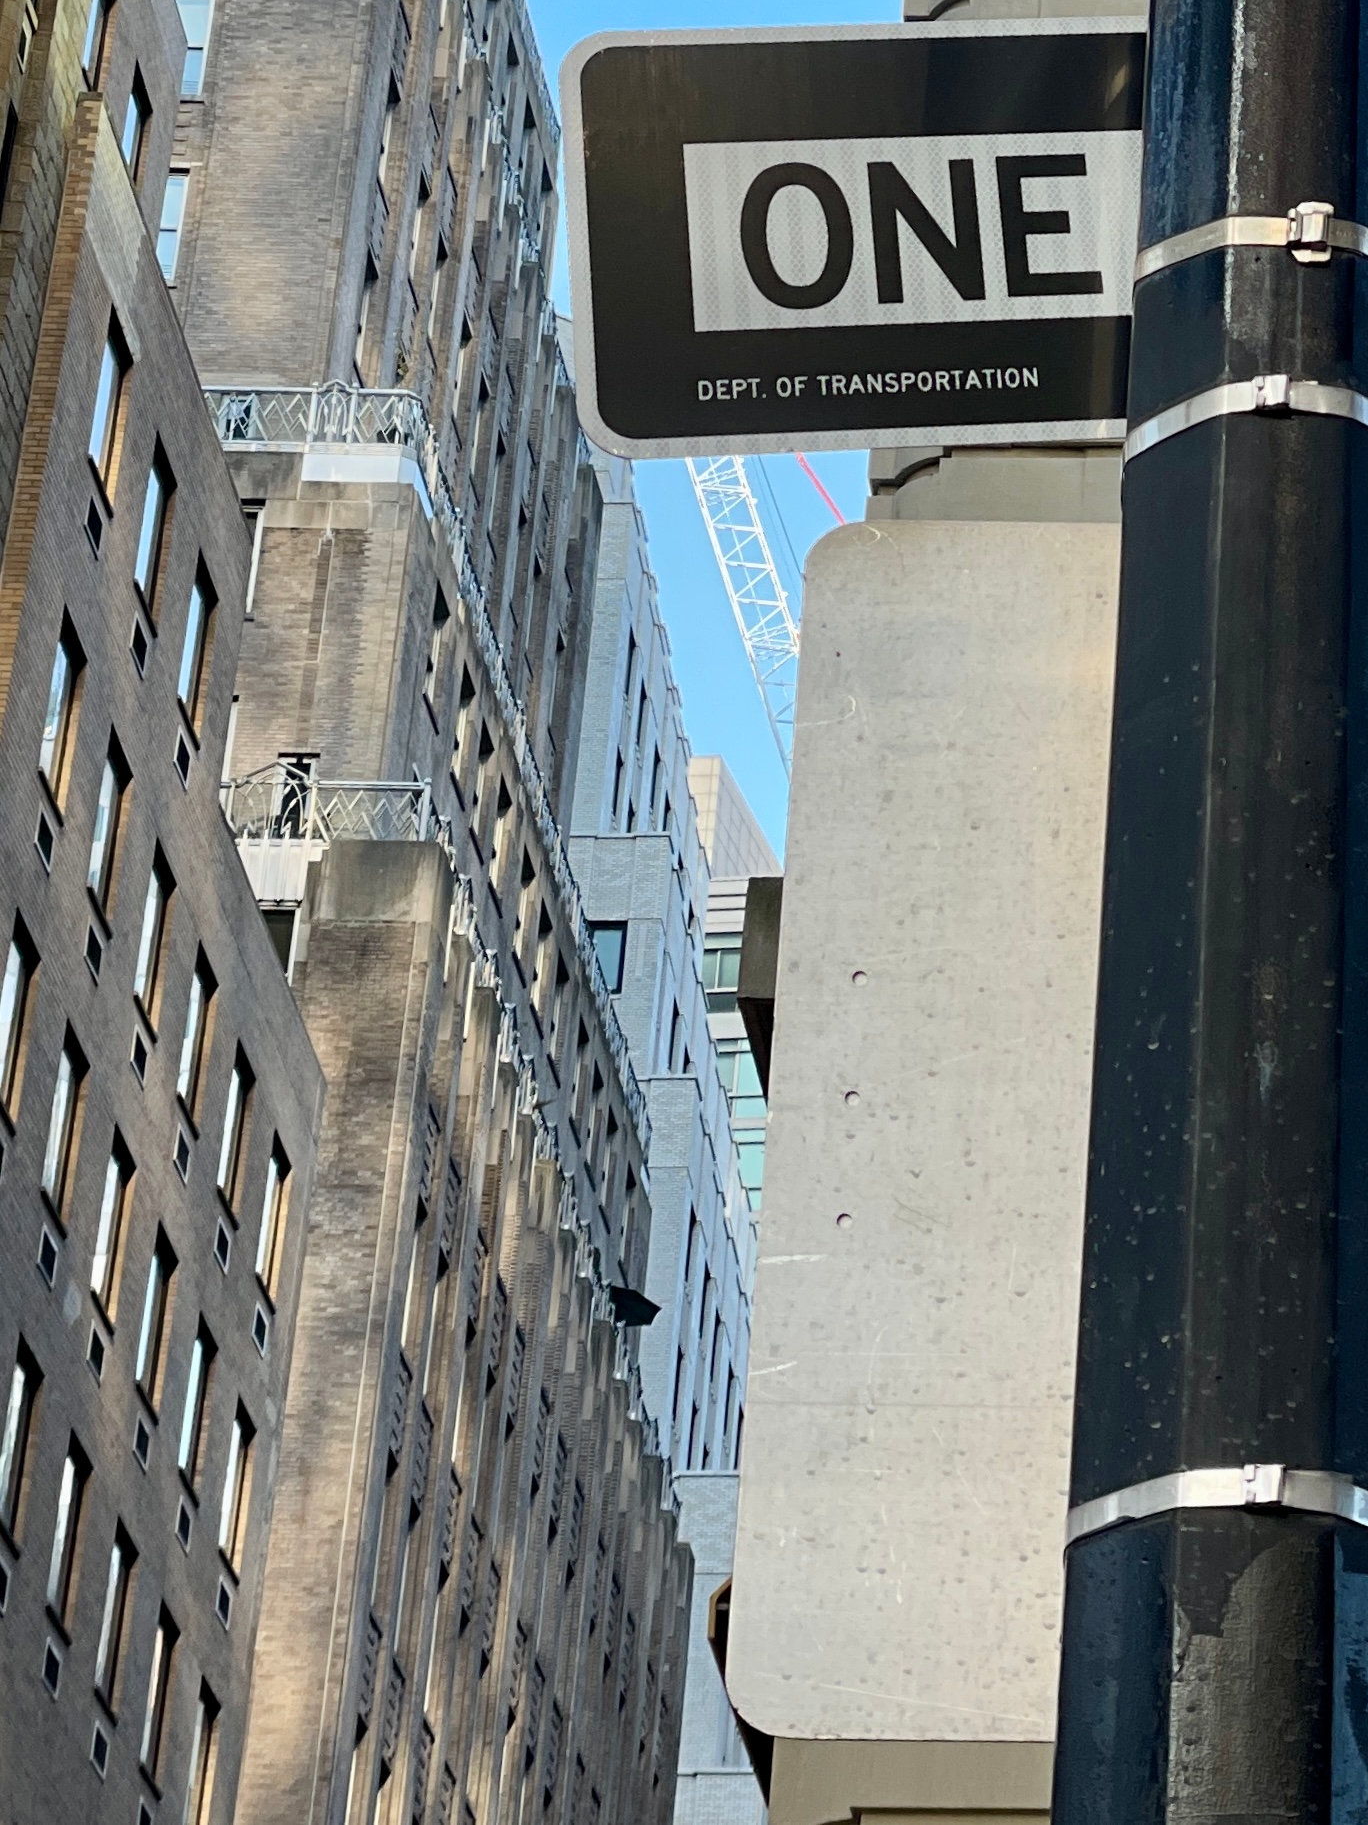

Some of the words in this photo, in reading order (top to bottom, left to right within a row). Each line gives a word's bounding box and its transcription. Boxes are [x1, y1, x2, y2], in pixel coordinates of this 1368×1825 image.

[740, 153, 1104, 310] ONE
[698, 378, 767, 401] DEPT.
[776, 376, 808, 398] OF
[816, 367, 1039, 396] TRANSPORTATION
